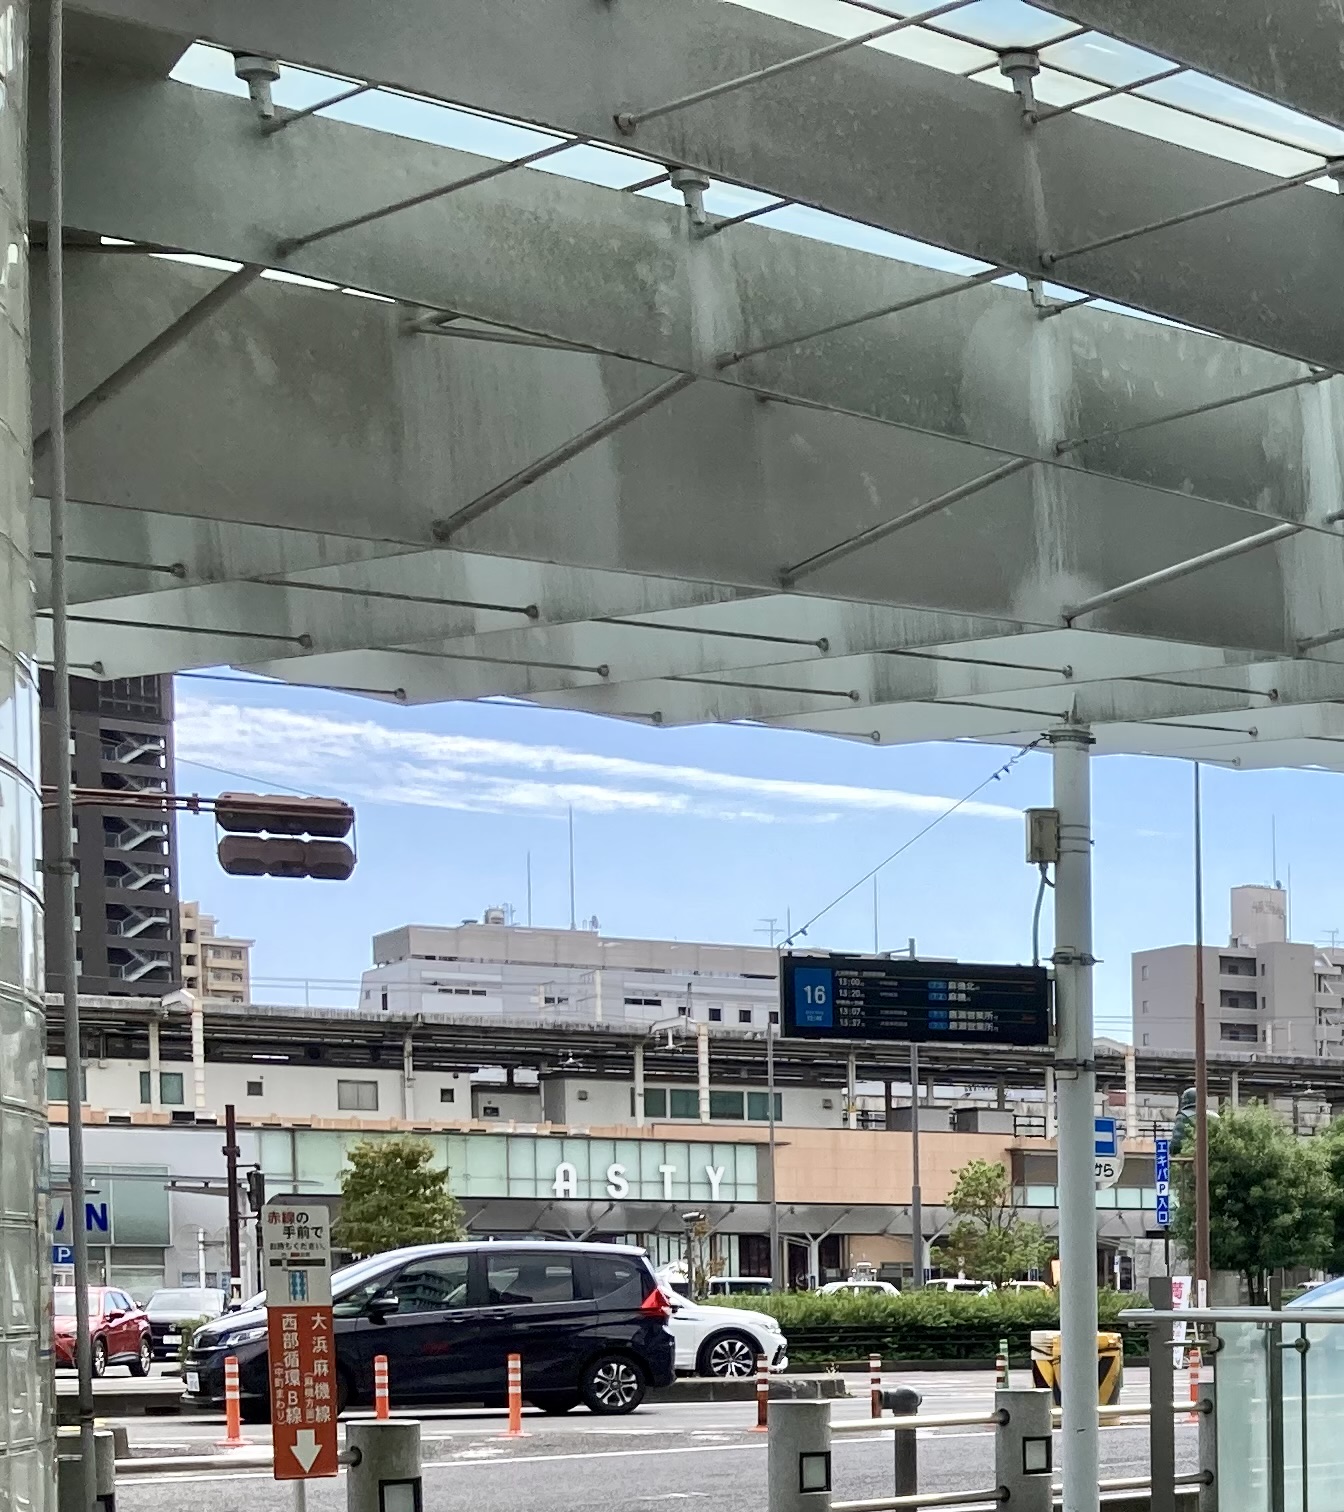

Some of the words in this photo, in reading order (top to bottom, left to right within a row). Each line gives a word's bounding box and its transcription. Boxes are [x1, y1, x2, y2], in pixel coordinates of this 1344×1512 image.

[803, 985, 826, 1005] 16
[552, 1161, 726, 1201] ASTY
[267, 1211, 309, 1225] 赤線の
[282, 1225, 324, 1240] 手前で
[58, 1247, 71, 1263] P
[311, 1312, 332, 1424] 大浜麻機線
